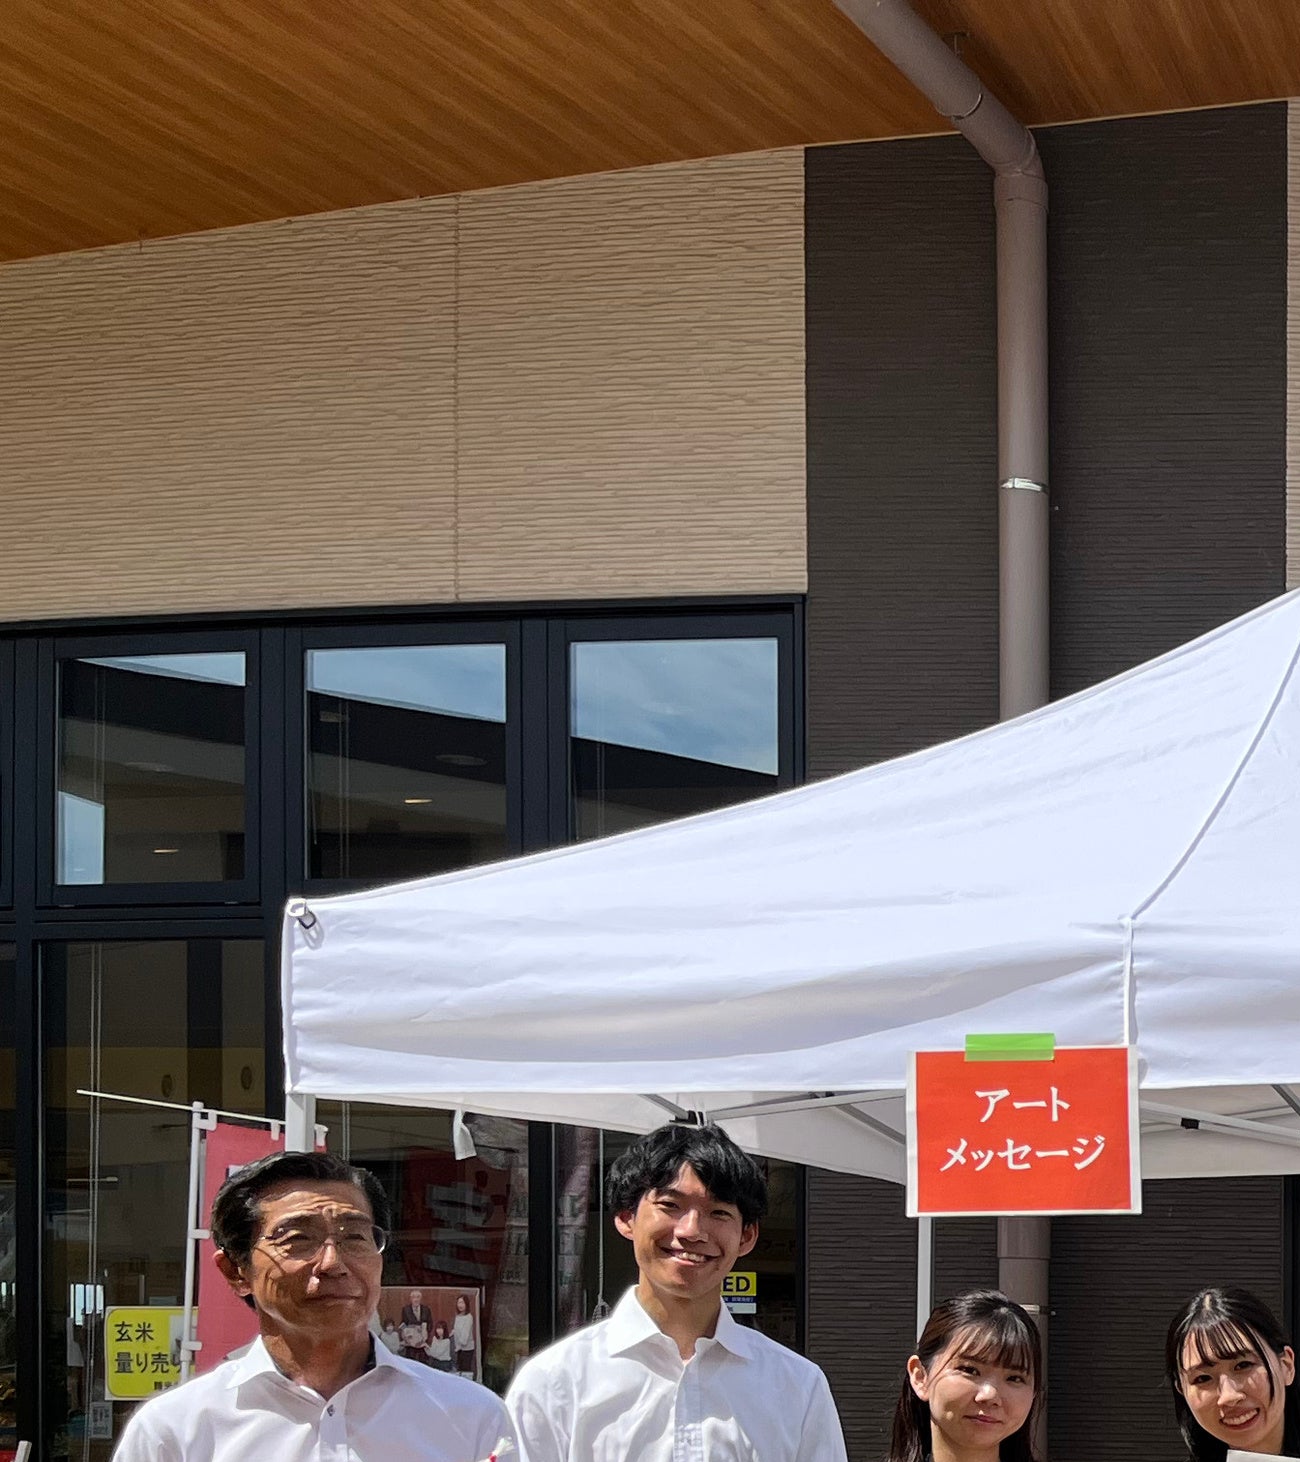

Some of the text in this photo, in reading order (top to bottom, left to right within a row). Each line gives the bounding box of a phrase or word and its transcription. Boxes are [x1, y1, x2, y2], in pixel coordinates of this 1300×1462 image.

[974, 1086, 1070, 1123] アート
[939, 1134, 1106, 1172] メッセージ
[723, 1276, 751, 1292] ED
[114, 1321, 154, 1343] 玄米
